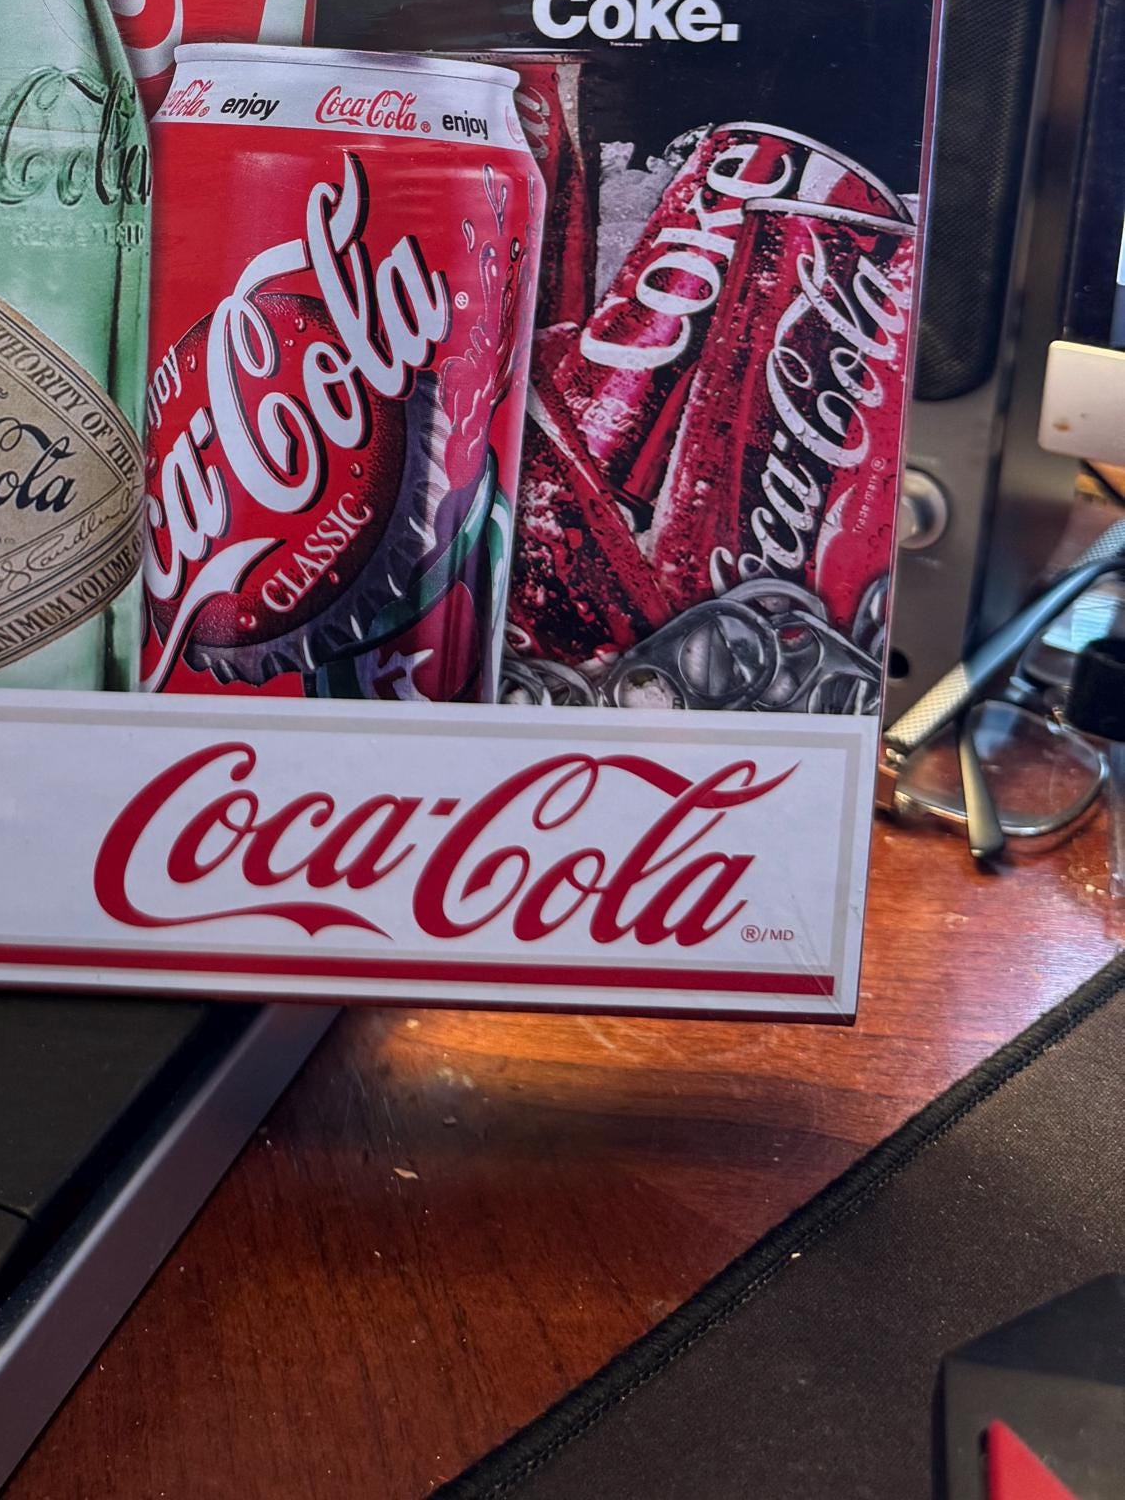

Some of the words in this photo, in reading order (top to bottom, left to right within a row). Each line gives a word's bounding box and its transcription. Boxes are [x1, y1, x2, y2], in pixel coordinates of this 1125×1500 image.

[220, 92, 280, 121] enjoy
[314, 84, 418, 132] Coca-Cola
[441, 109, 489, 140] enjoy
[579, 142, 793, 370] Coke
[80, 410, 114, 442] OF
[143, 149, 450, 690] ca-Cola
[66, 548, 136, 610] VOLUME
[259, 492, 375, 614] CLASSIC
[93, 741, 803, 947] Coca-Cola
